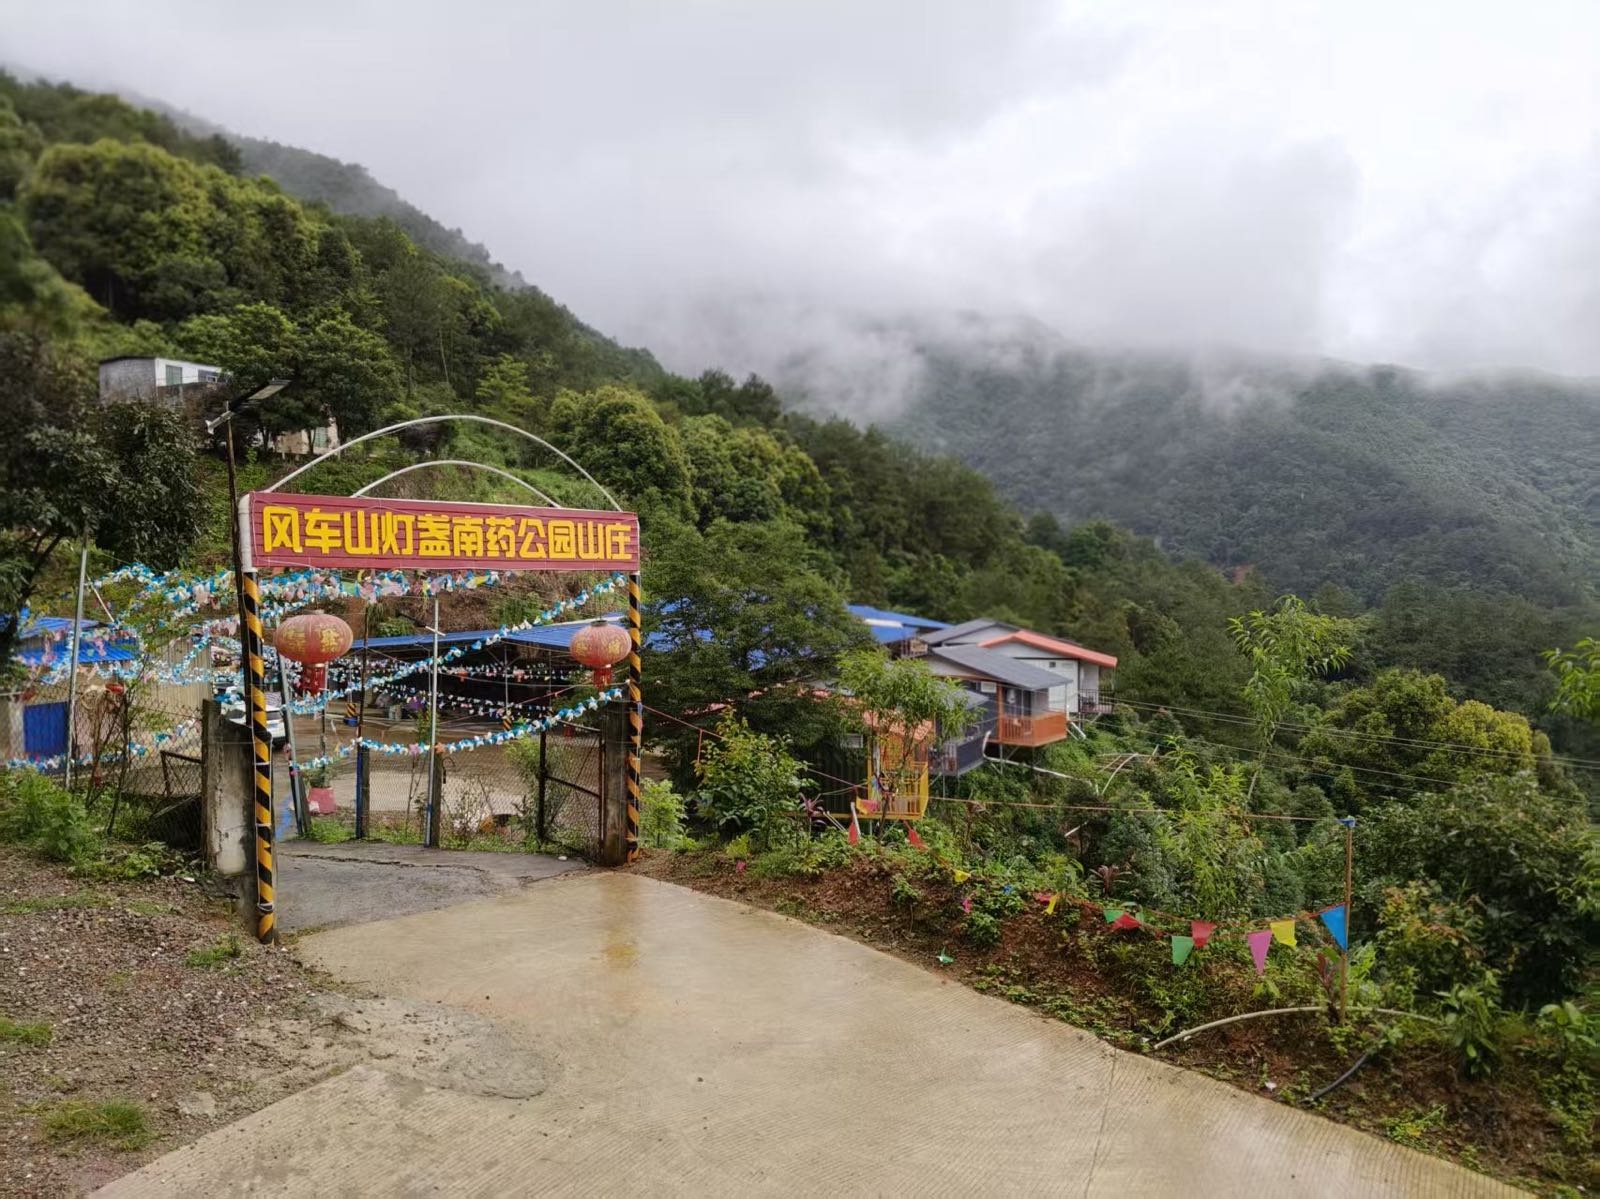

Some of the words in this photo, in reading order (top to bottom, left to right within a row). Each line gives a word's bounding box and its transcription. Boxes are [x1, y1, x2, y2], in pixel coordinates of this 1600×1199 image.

[262, 505, 633, 560] 风车山灯盏南药公园山庄
